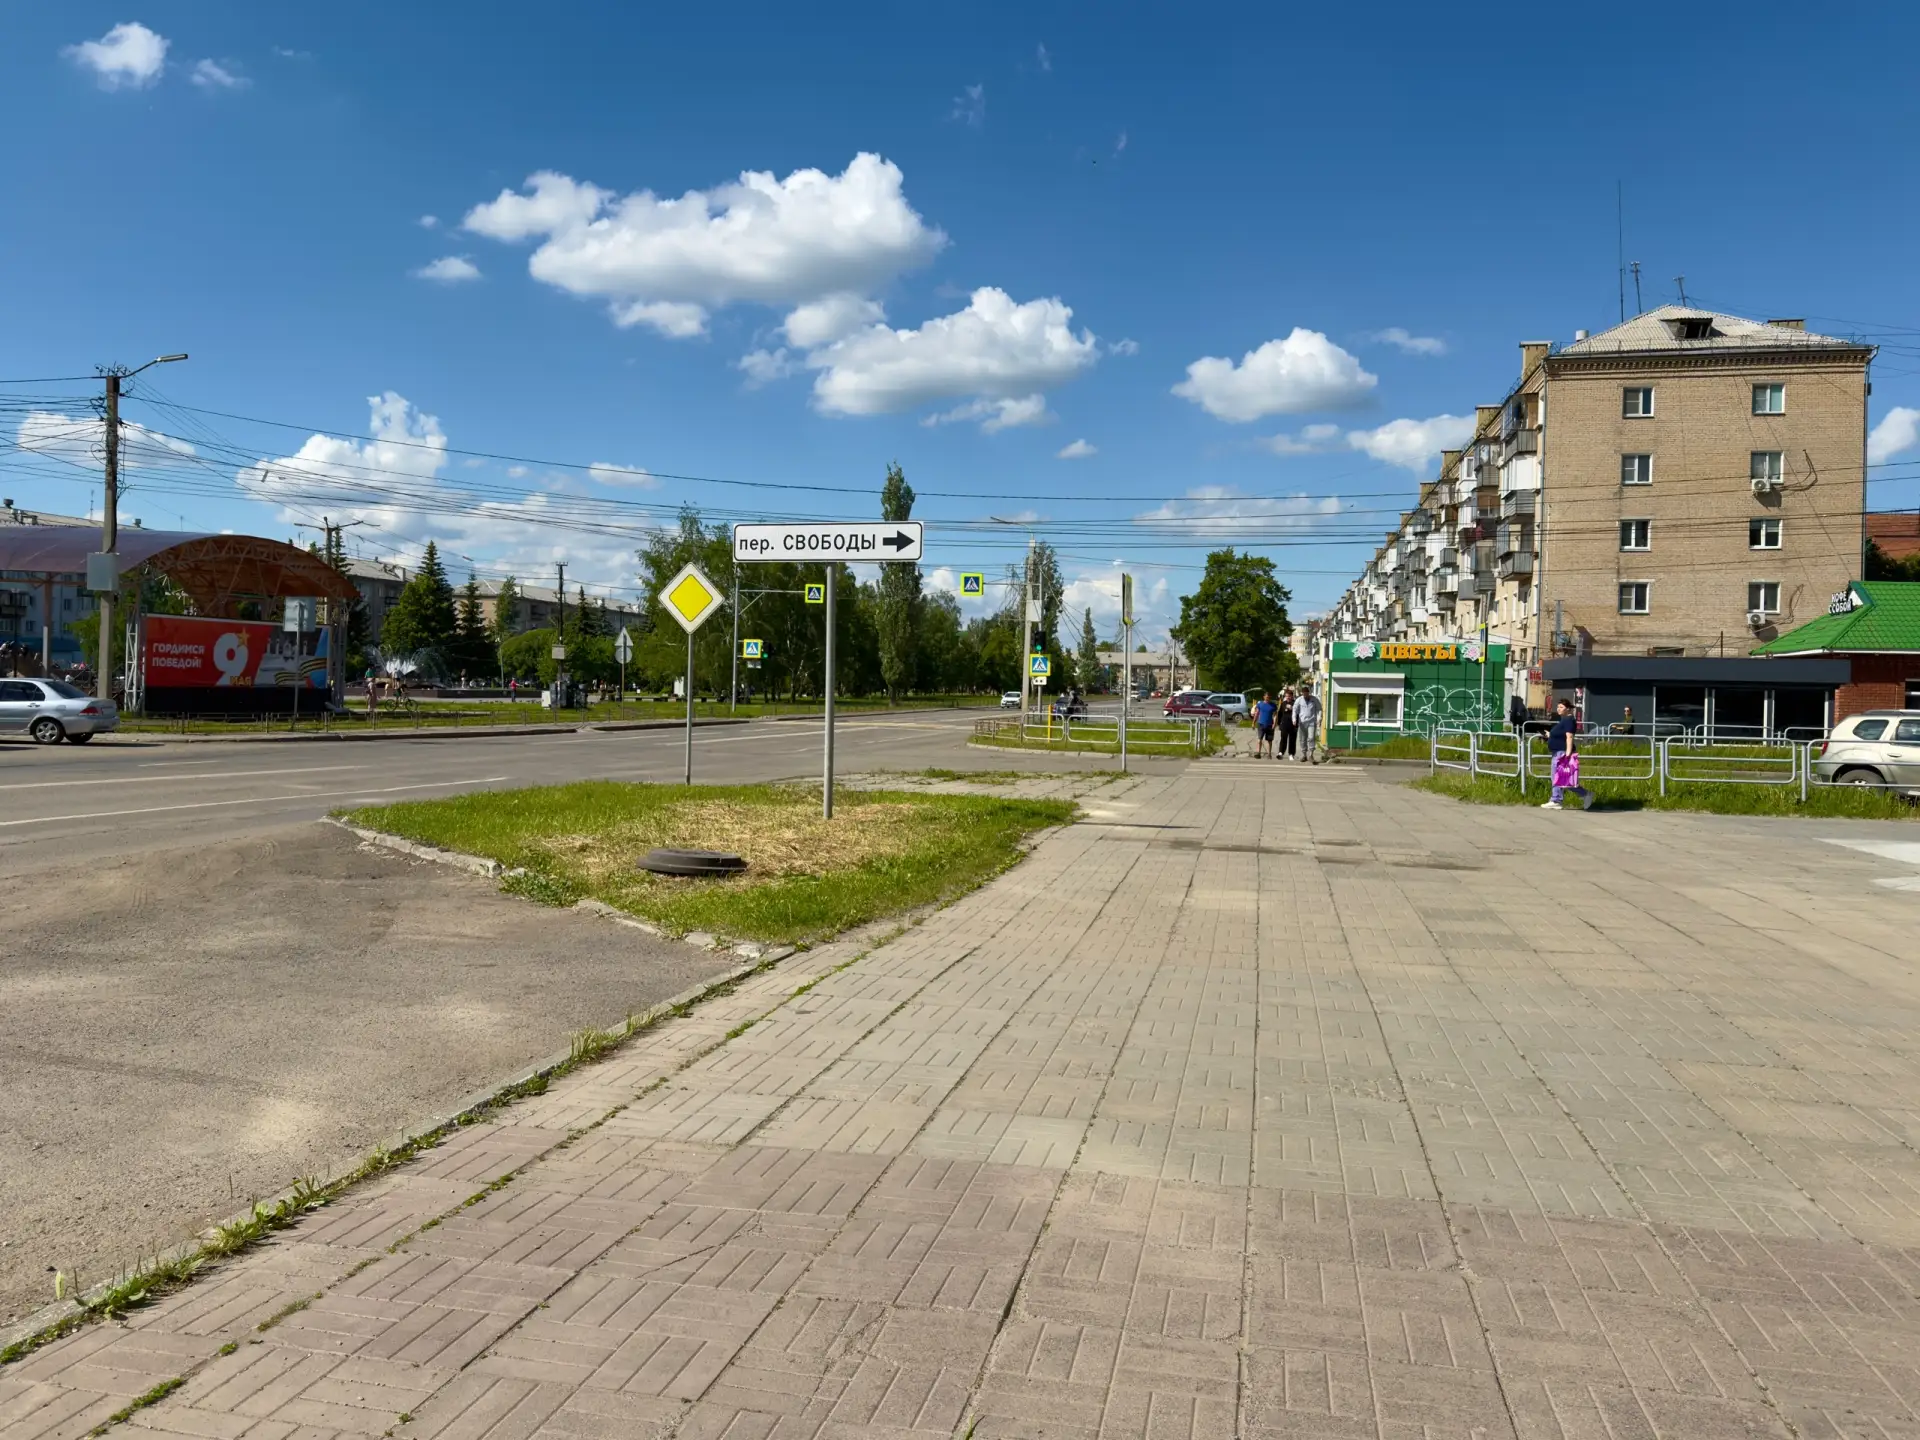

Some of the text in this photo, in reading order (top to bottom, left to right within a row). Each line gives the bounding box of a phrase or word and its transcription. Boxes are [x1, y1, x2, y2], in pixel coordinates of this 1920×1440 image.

[739, 534, 876, 554] пер. СВОБОДЫ
[152, 642, 205, 655] ГОРДИМСЯ
[1380, 643, 1457, 662] ЦВЕТЫ
[151, 656, 202, 669] ПОБЕДОЙ!
